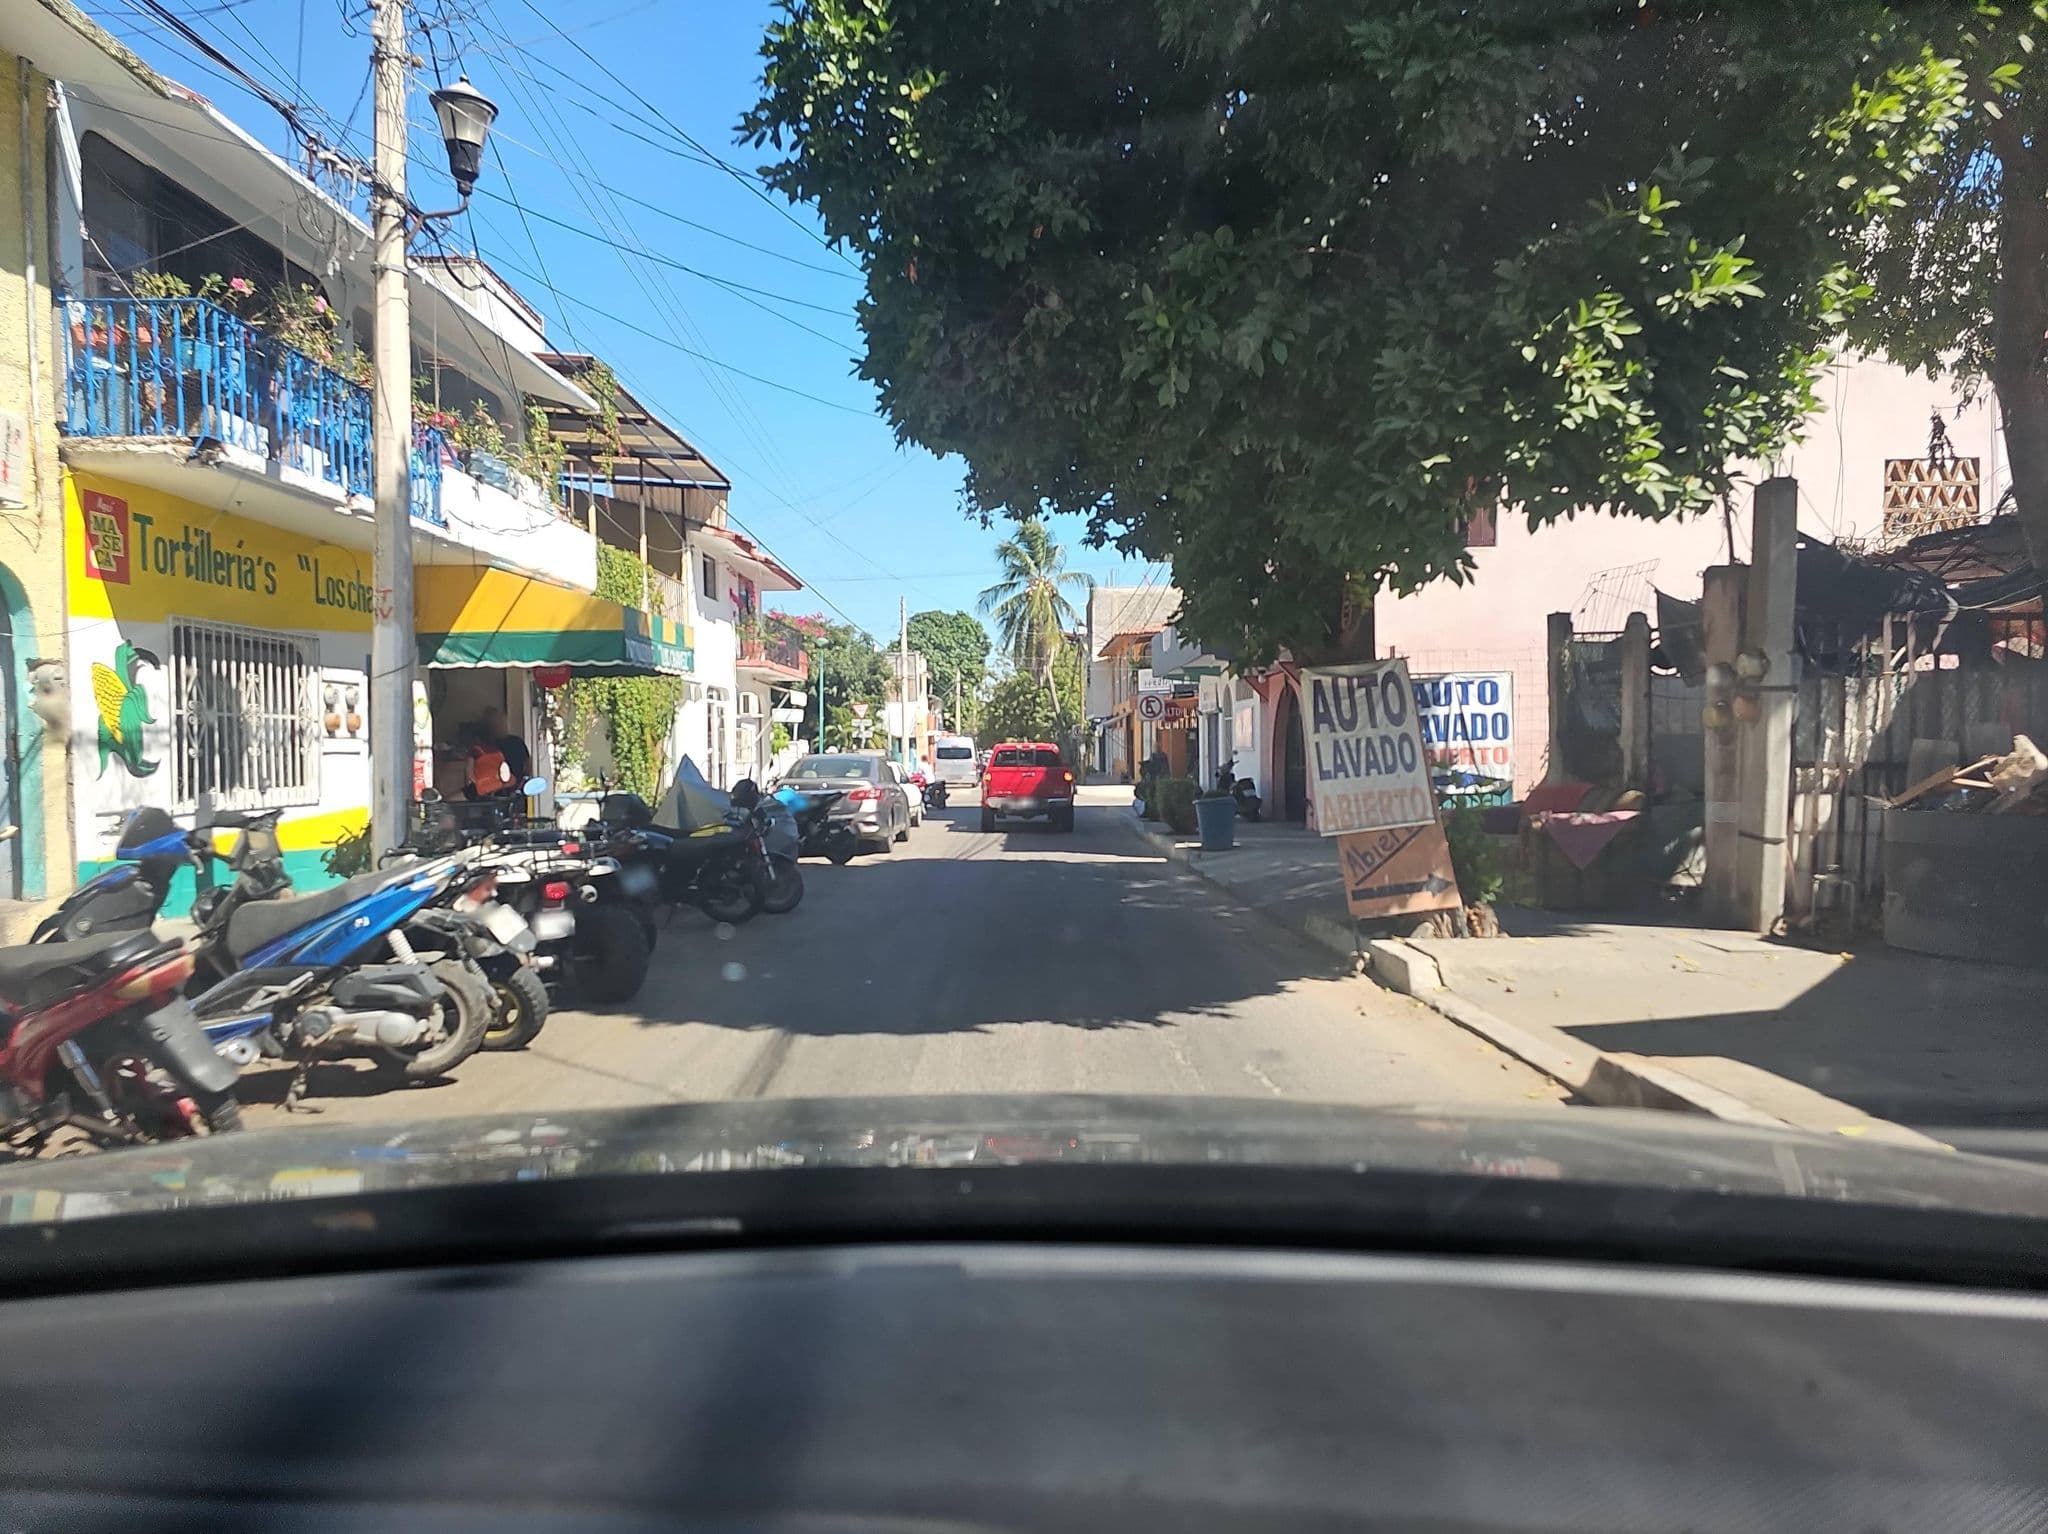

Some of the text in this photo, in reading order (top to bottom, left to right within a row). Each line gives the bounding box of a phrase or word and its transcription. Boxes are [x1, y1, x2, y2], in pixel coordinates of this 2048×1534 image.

[93, 514, 117, 535] MA
[95, 549, 114, 568] CA
[102, 534, 121, 553] SE
[1312, 670, 1408, 734] AUTO
[1411, 679, 1500, 708] AUTO
[1417, 711, 1509, 743] AVADO
[1314, 731, 1418, 782] LAVADO
[1323, 785, 1428, 831] ABIERTO
